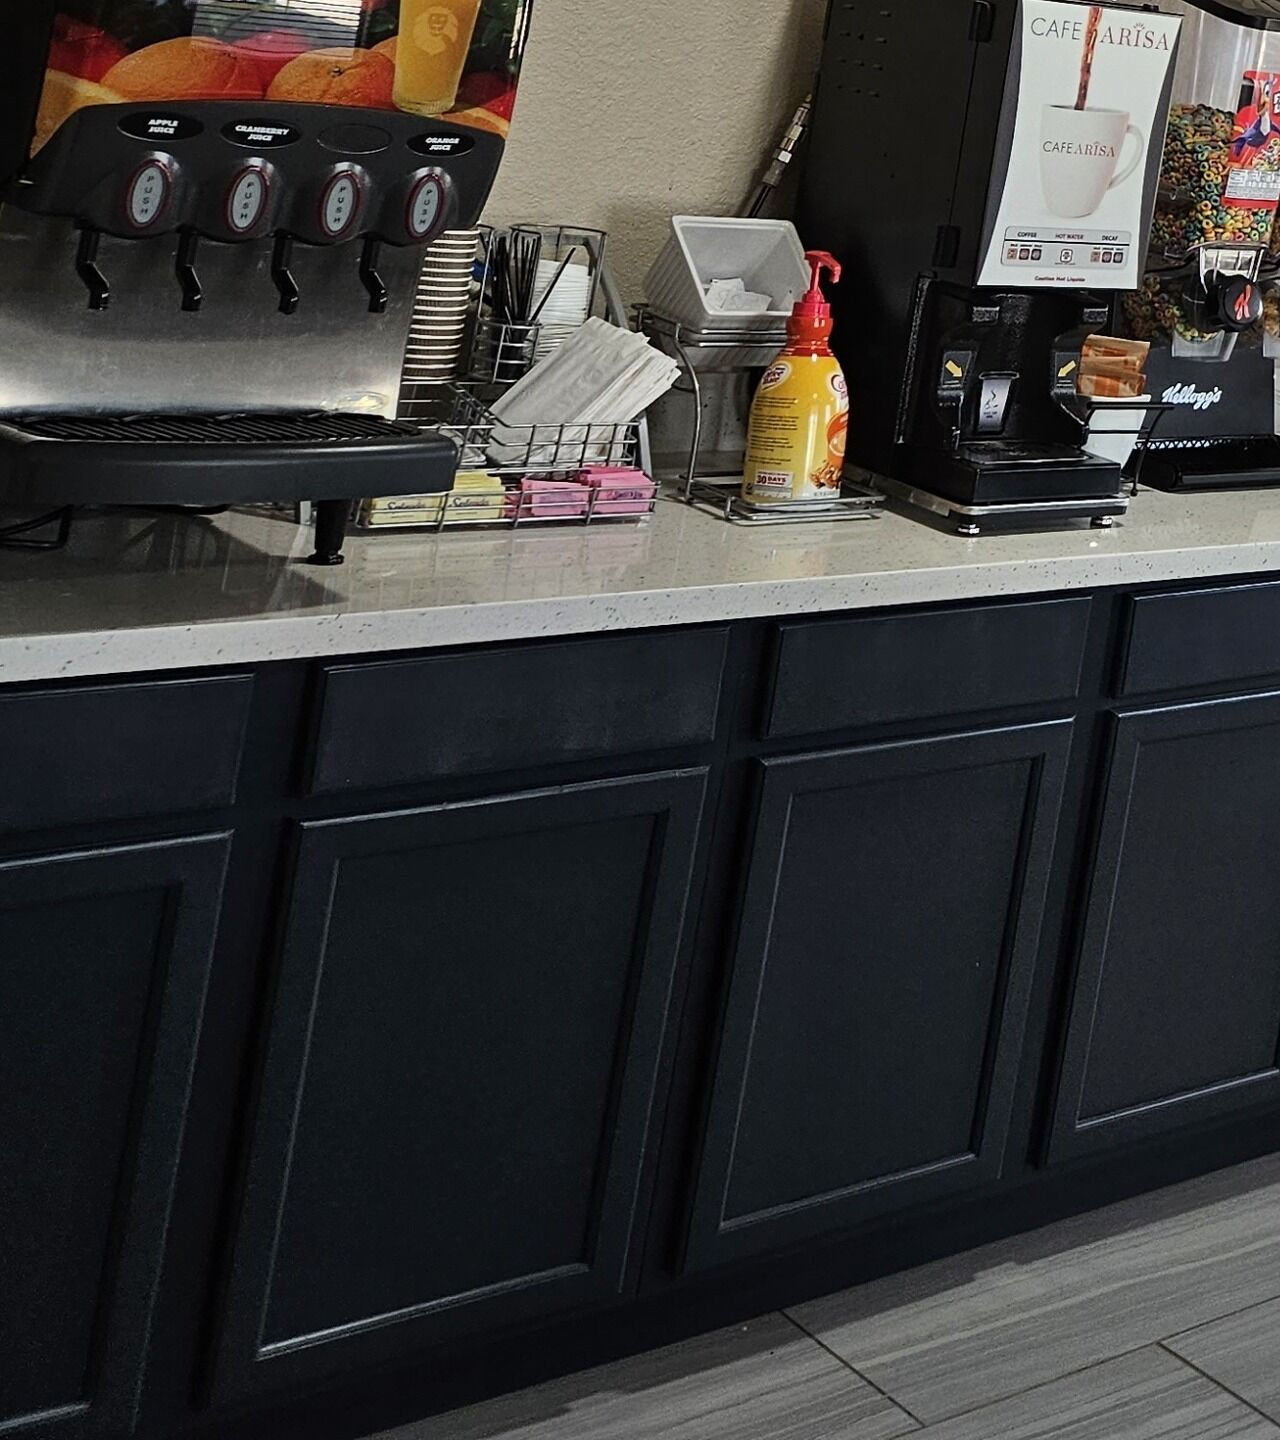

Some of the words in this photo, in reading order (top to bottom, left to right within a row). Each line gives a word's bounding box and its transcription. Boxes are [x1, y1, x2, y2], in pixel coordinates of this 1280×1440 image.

[148, 119, 179, 127] APPLE
[148, 126, 175, 135] JUICE
[235, 124, 290, 136] CRANBERRY
[247, 133, 274, 142] JUICE
[139, 175, 155, 215] PUSH
[239, 181, 255, 220] PUSH
[333, 186, 347, 224] PUSH
[419, 189, 434, 225] PUSH
[1161, 382, 1223, 410] Kellogg's
[756, 474, 767, 485] 30
